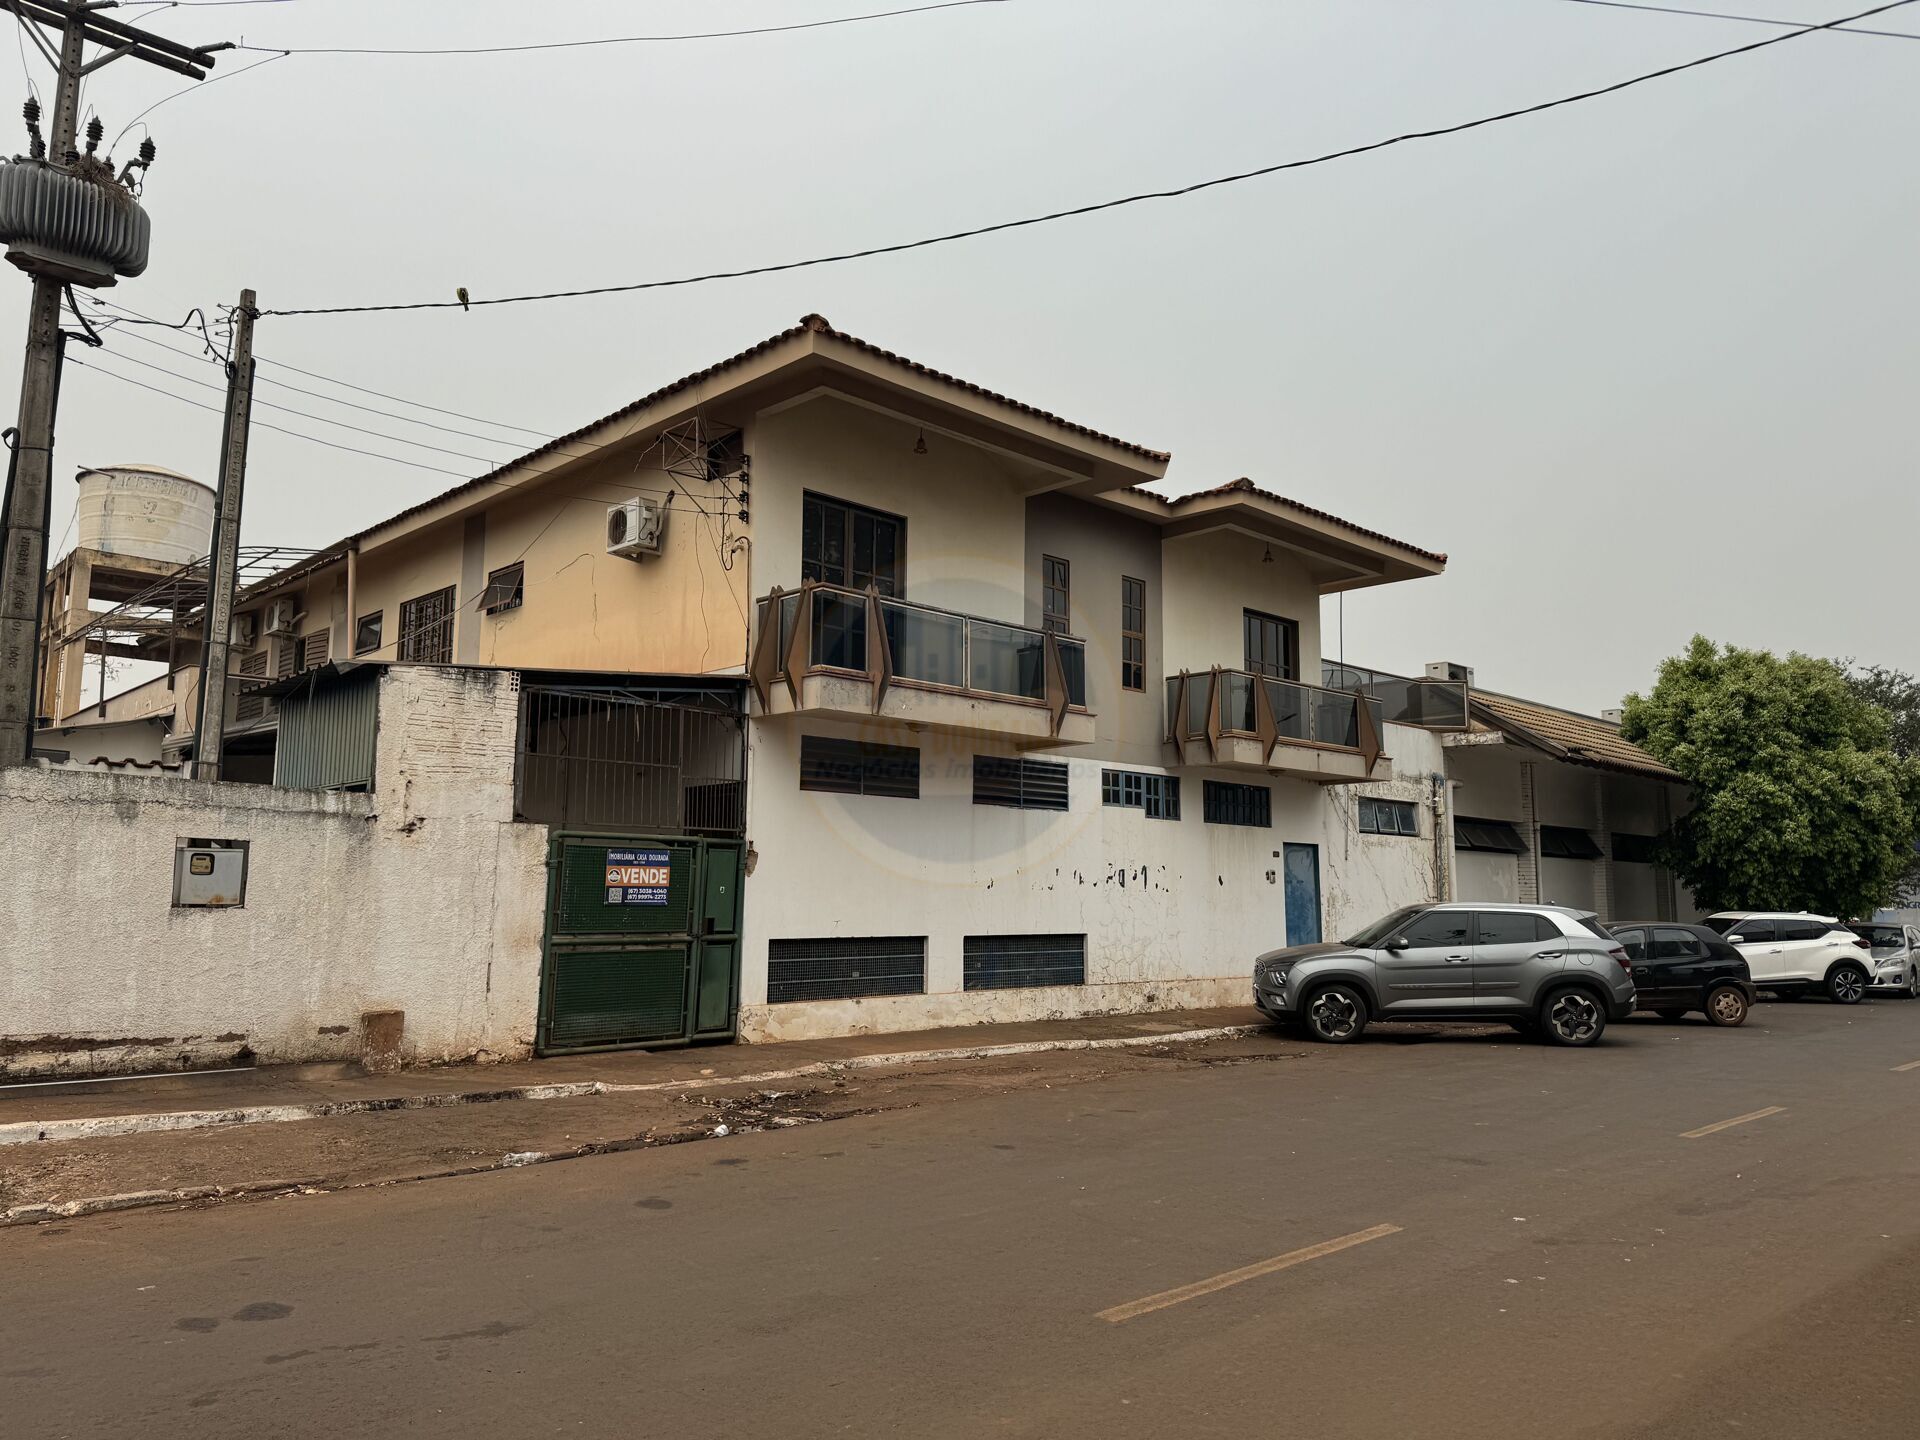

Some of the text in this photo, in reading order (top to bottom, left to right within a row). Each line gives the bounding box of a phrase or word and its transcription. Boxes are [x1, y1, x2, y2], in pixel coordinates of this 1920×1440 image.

[609, 852, 635, 860] IMOBILIÁRIA
[637, 853, 647, 861] CASA
[621, 868, 667, 884] VENDE
